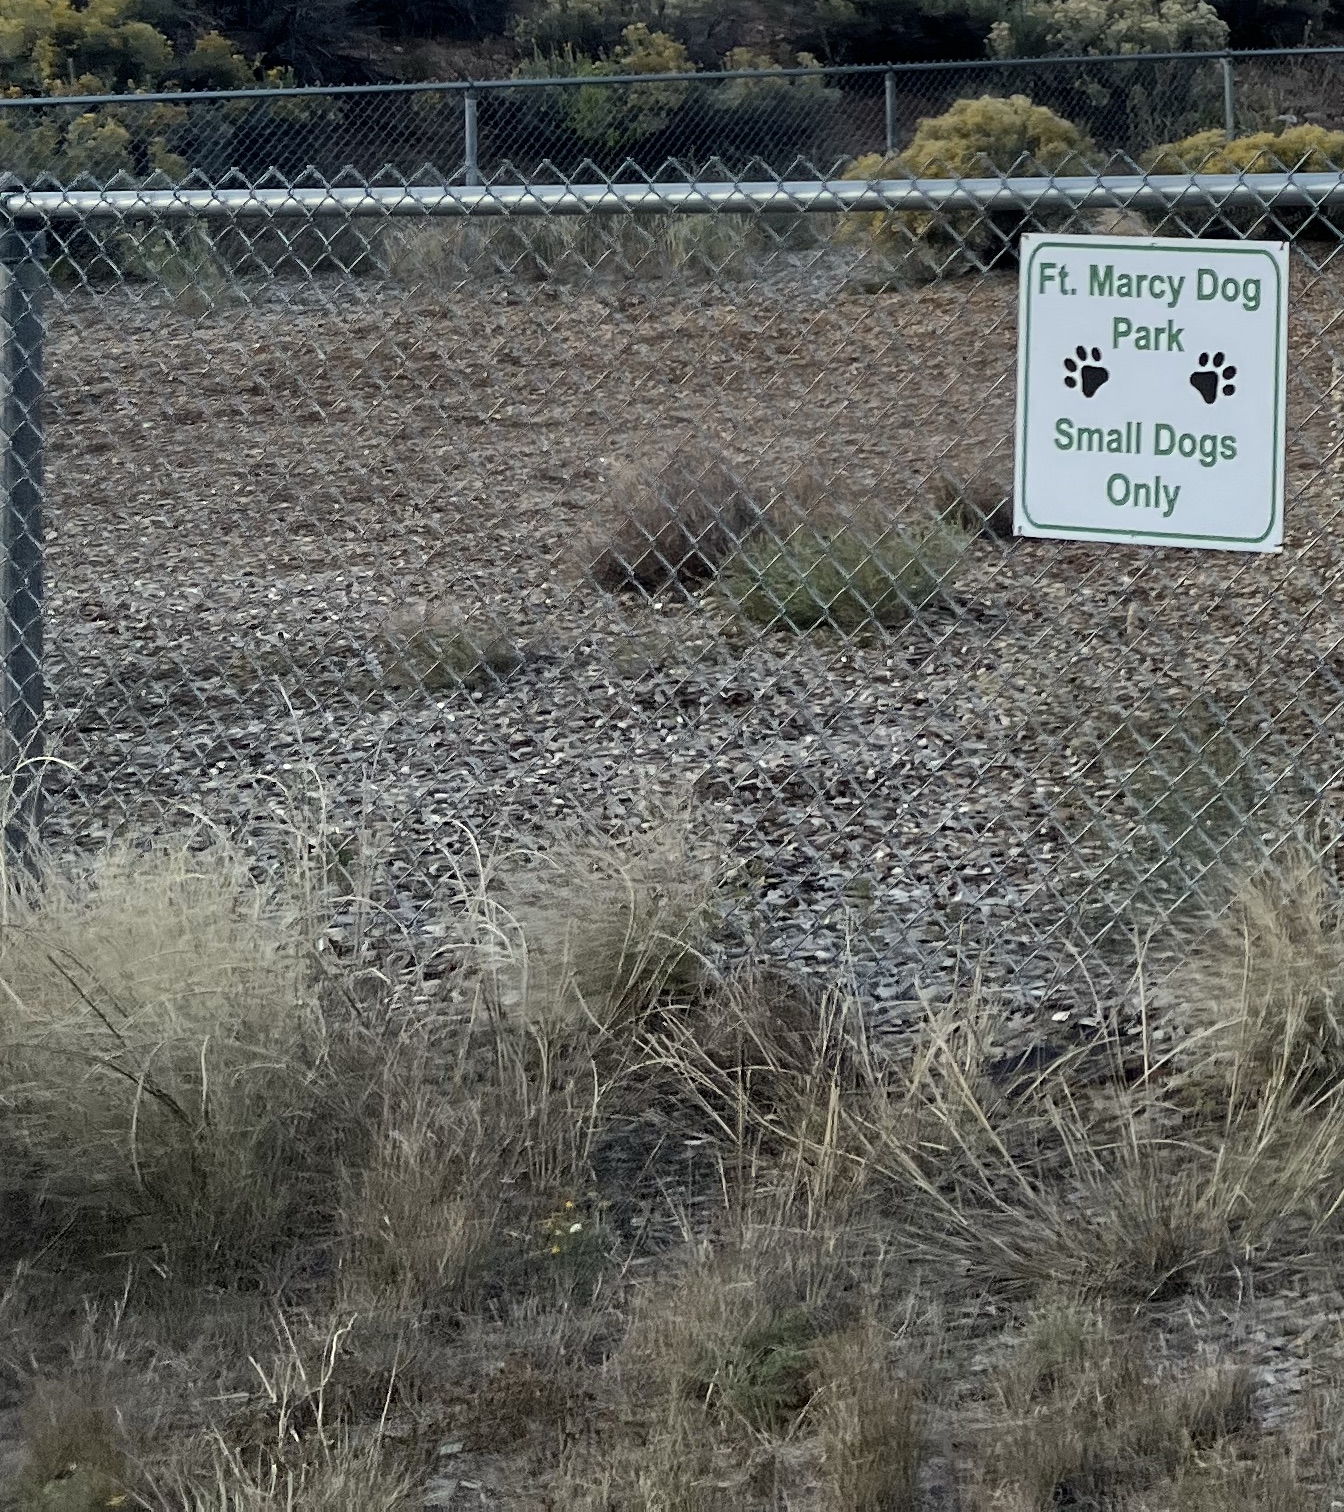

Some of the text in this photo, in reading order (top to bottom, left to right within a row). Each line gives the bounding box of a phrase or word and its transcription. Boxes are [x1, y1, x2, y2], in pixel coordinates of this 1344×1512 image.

[1039, 263, 1261, 312] Ft. Marcy Dog
[1112, 317, 1185, 352] Park
[1054, 418, 1238, 467] Small Dogs
[1106, 473, 1181, 517] Only
